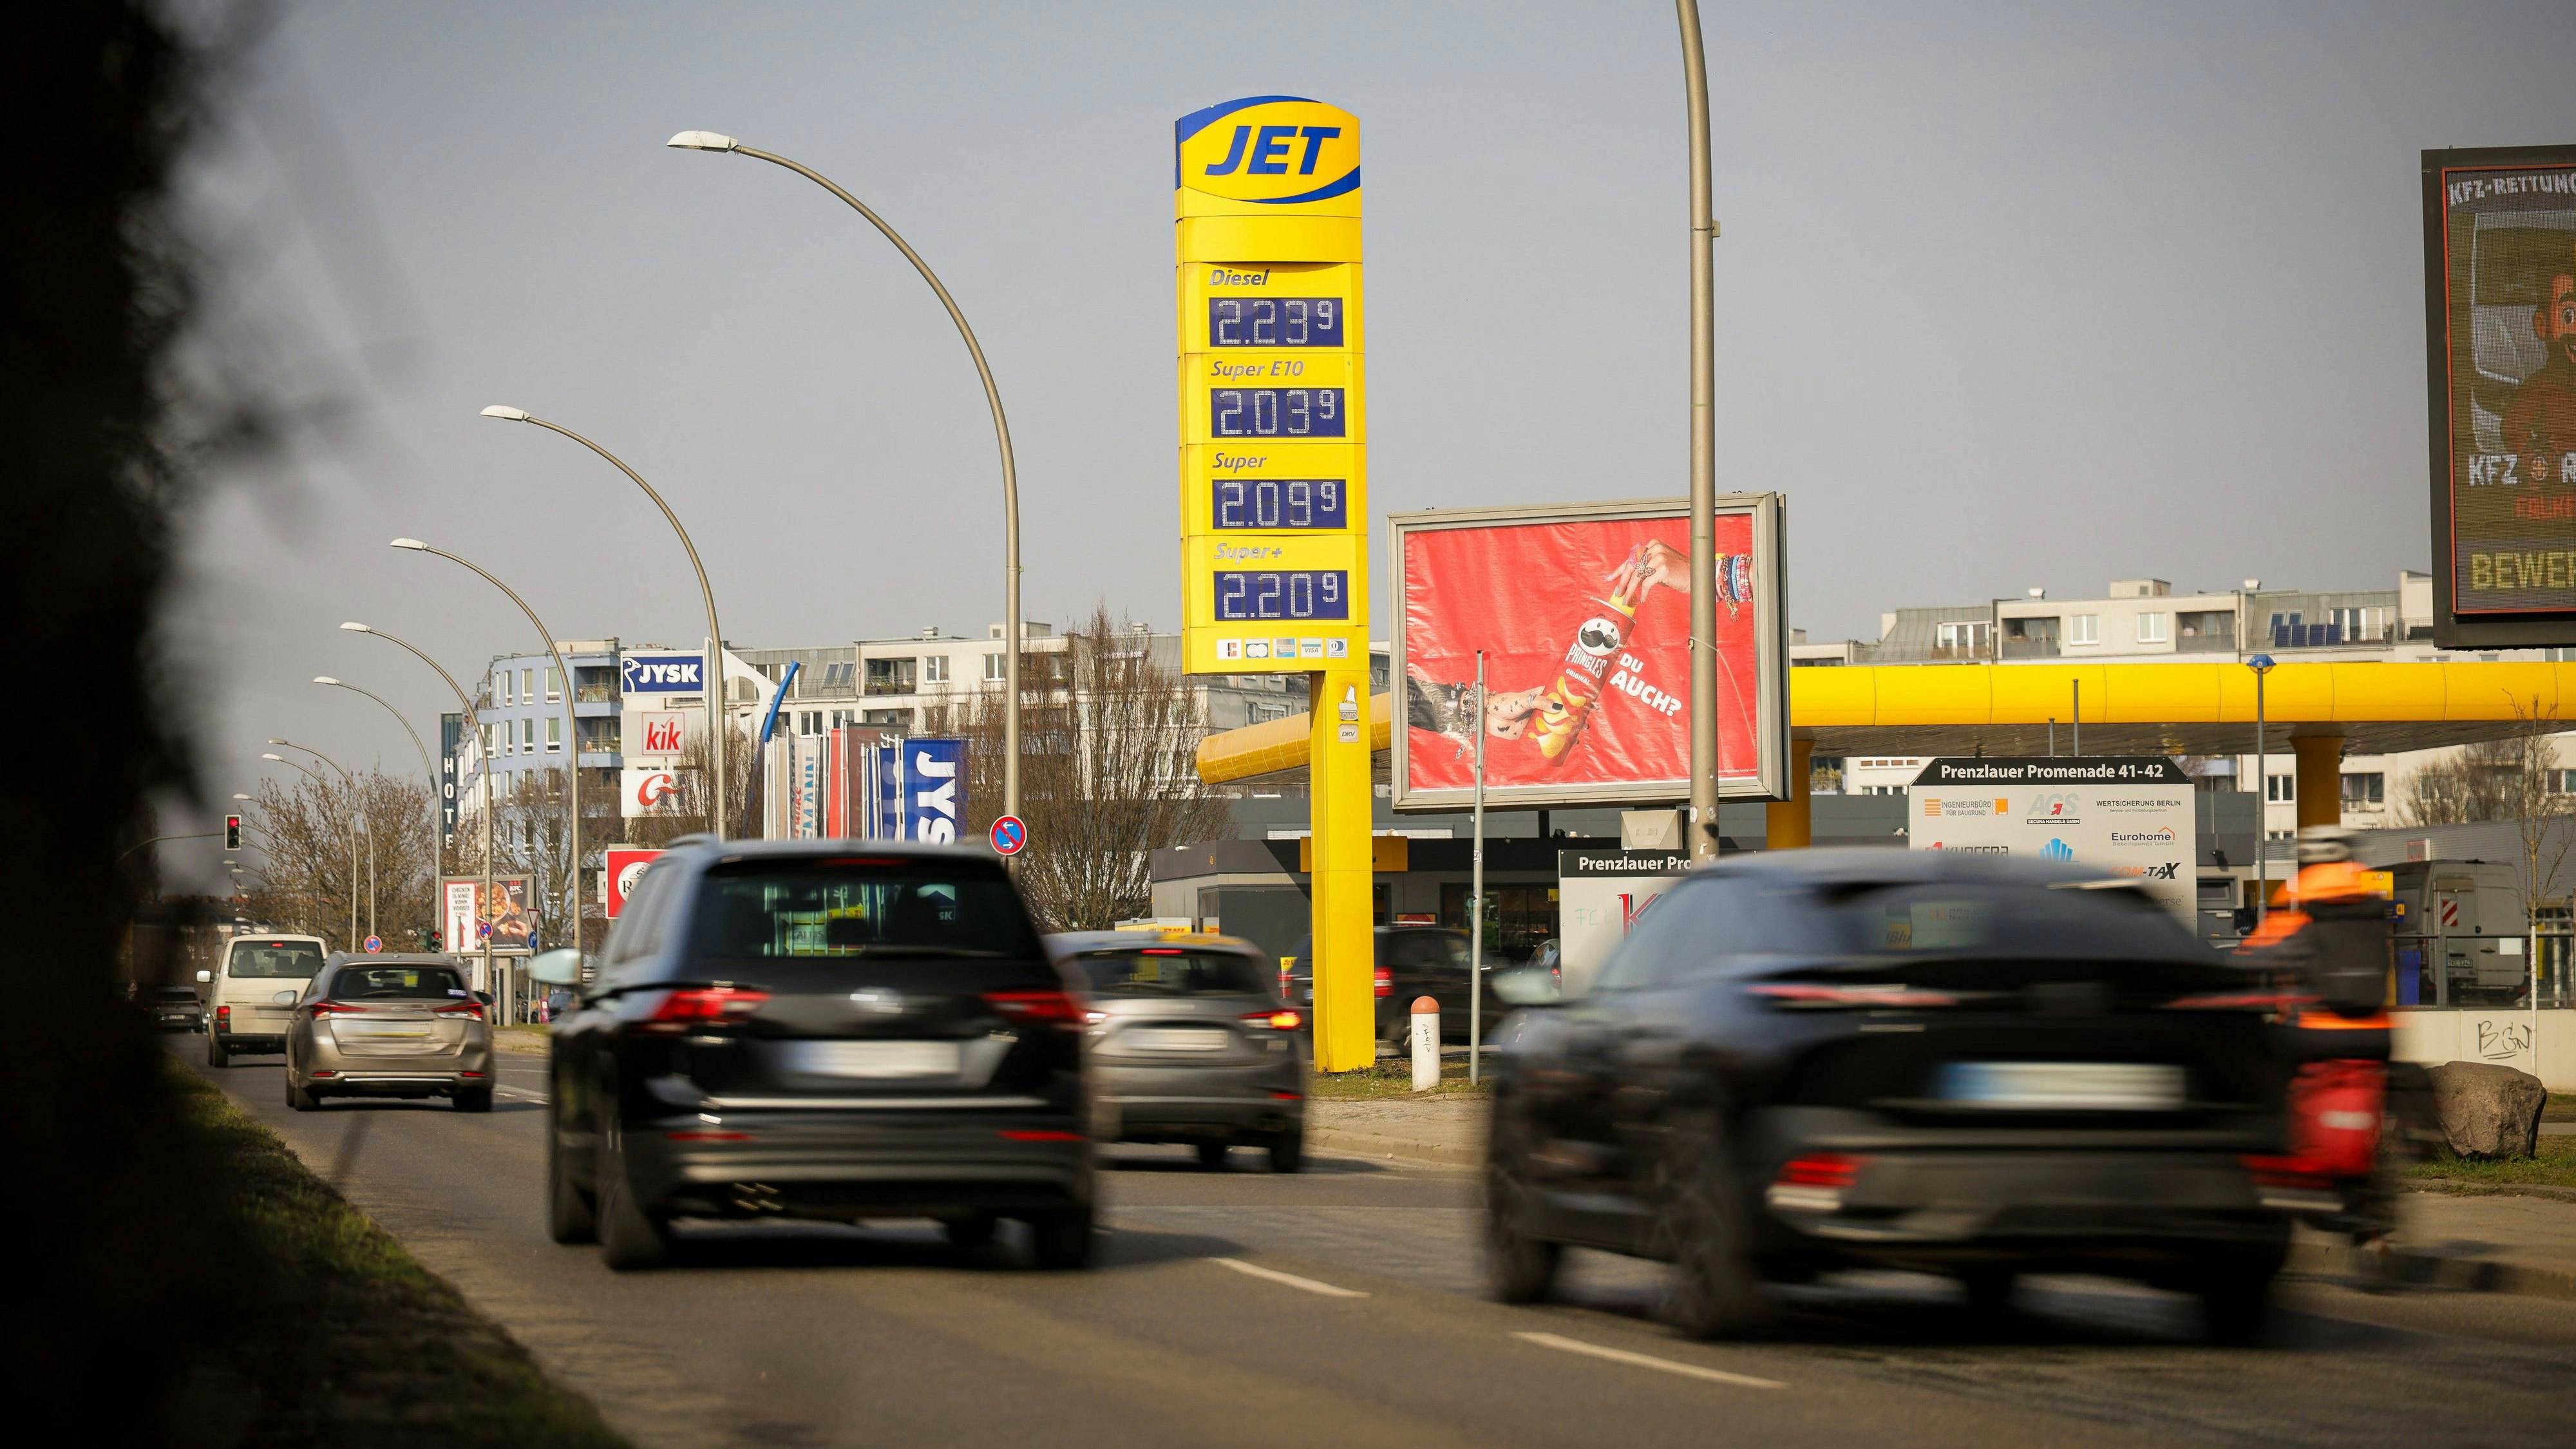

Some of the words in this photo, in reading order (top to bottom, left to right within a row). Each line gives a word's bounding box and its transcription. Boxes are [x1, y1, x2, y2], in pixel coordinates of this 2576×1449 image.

[1204, 126, 1341, 175] JET
[1209, 269, 1270, 286] Diesel
[1218, 299, 1334, 345] 2.239
[1211, 361, 1265, 381] Super
[1270, 361, 1304, 377] E10
[1219, 389, 1335, 435] 2.039
[1212, 452, 1267, 473] Super
[2468, 455, 2518, 486] KFZ
[1222, 482, 1337, 527] 2.099
[1214, 542, 1283, 564] Super+
[1223, 573, 1338, 618] 2.209
[1565, 642, 1607, 679] PRINGLES
[1619, 652, 1644, 674] DU
[638, 664, 700, 684] JYSK
[1566, 668, 1591, 685] ORIGINAL
[1609, 669, 1681, 717] AUCH?
[646, 721, 681, 750] kik
[1941, 764, 2024, 779] Prenzlauer
[2027, 764, 2116, 778] Promenade
[2118, 764, 2164, 778] 41-42
[443, 757, 455, 850] HOTE
[916, 750, 956, 846] JYS
[1942, 799, 1991, 809] INGENIEURBÜRO
[2111, 832, 2172, 841] Eurohome
[1579, 856, 1663, 870] Prenzlauer
[1667, 856, 1691, 869] Pro
[2109, 862, 2181, 880] COM-TAX
